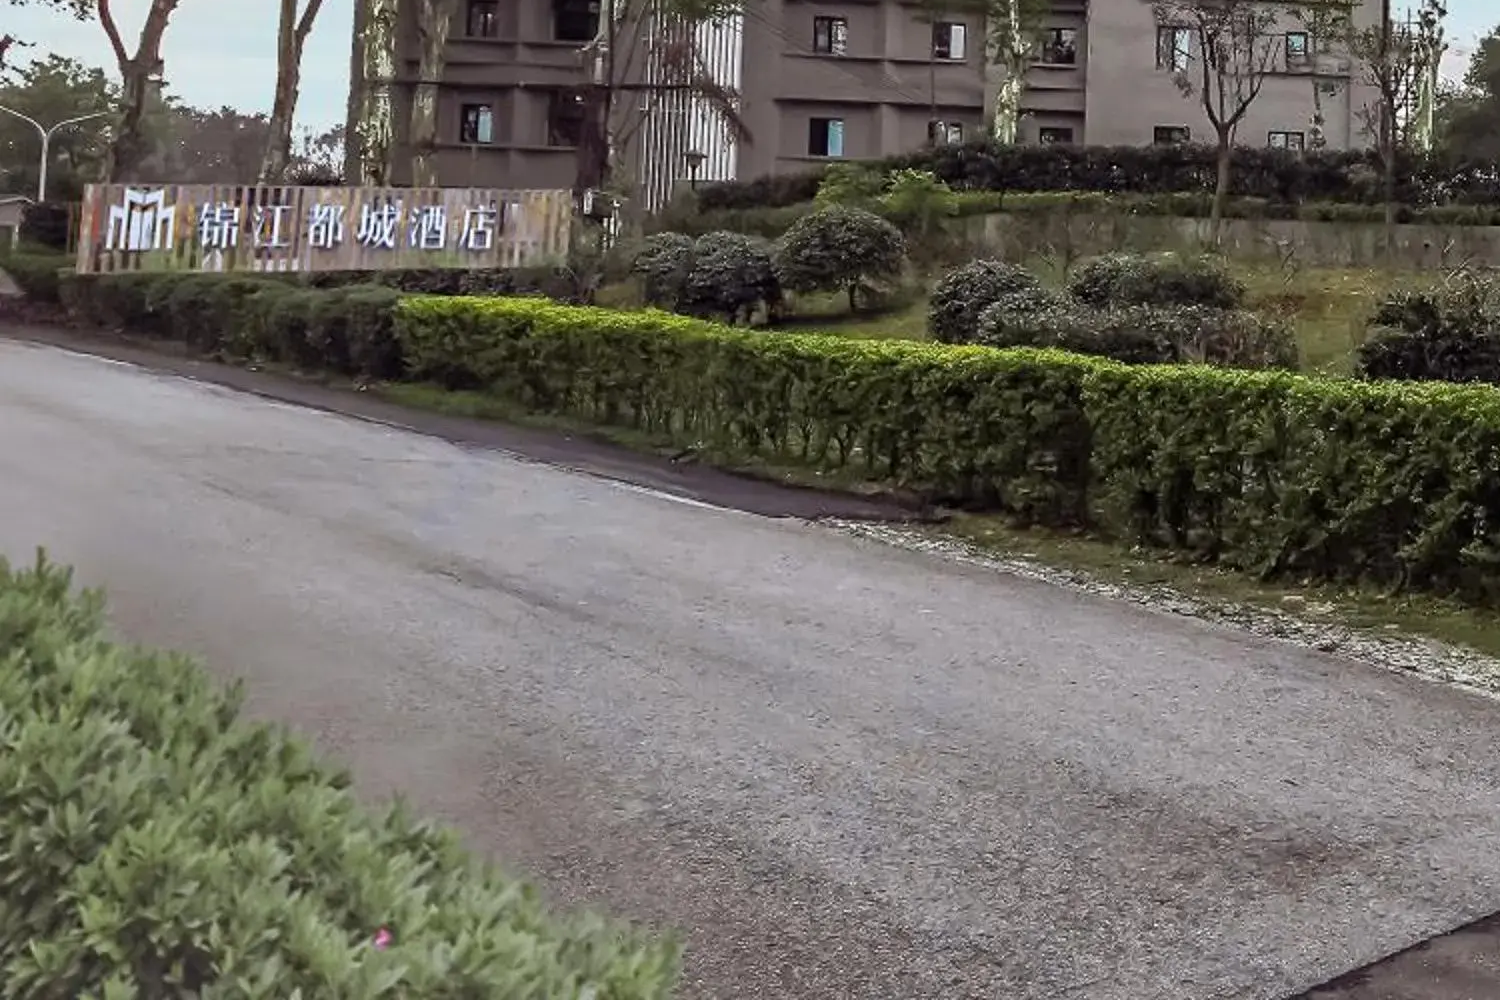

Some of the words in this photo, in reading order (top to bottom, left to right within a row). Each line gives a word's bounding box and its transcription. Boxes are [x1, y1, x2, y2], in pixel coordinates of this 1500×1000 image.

[200, 202, 497, 250] 锦江都城酒店
